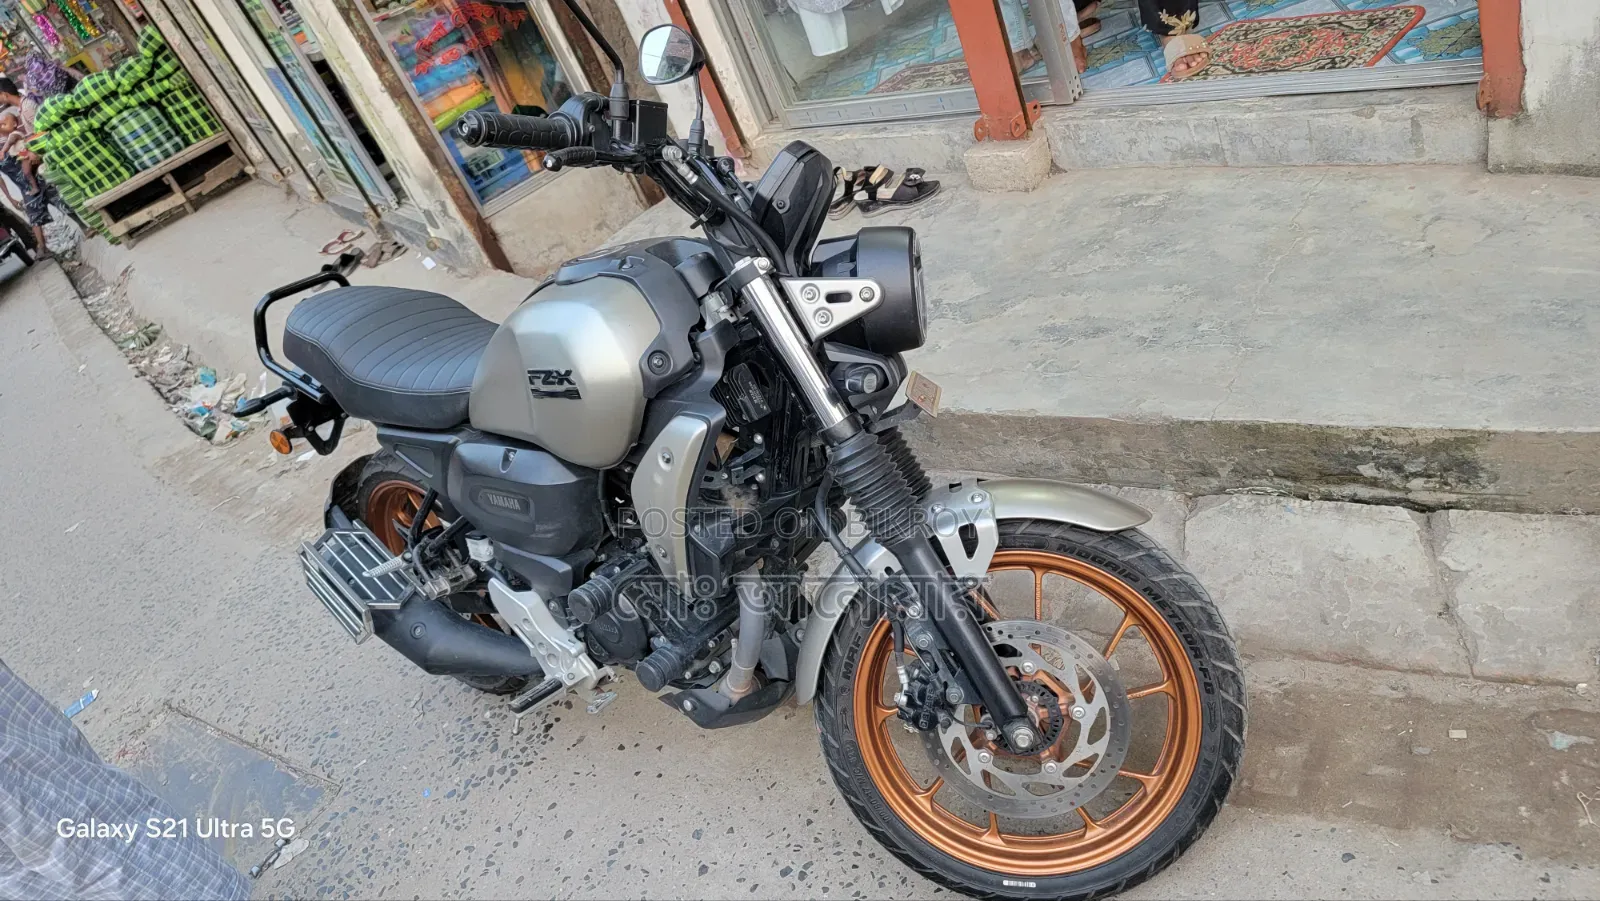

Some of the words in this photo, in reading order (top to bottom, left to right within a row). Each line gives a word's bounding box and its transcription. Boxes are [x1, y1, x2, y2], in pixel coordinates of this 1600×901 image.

[487, 493, 521, 511] YAMAHA
[1056, 543, 1141, 583] MOGRIP
[841, 631, 862, 681] MRF
